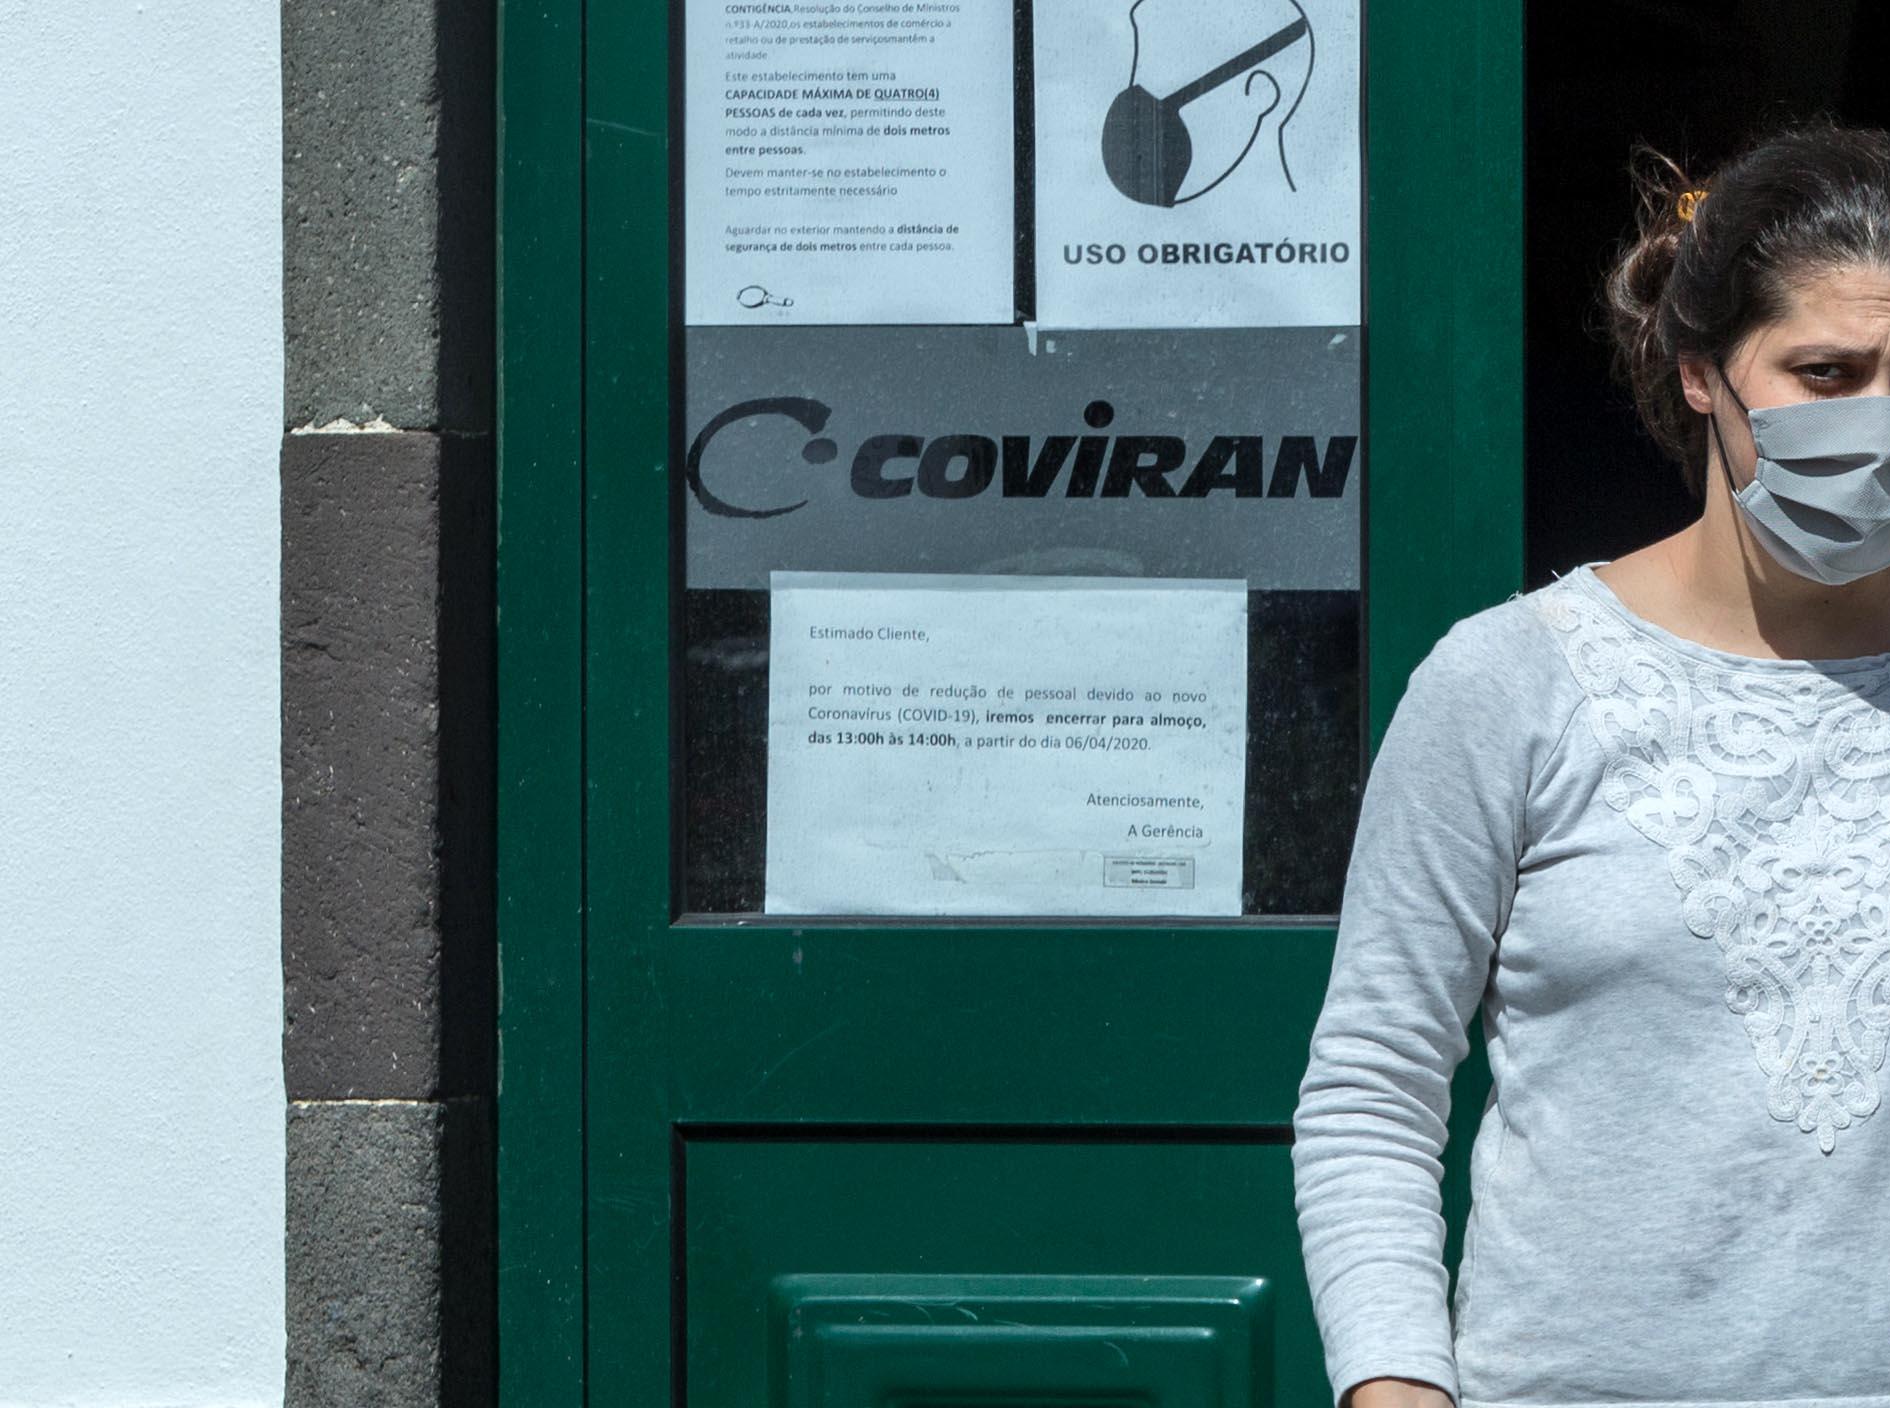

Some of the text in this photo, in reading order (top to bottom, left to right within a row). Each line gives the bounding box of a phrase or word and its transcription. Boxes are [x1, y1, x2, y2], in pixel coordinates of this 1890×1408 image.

[725, 71, 896, 82] Este estabelecimento tem uma
[725, 90, 799, 100] CAPACIDADE
[802, 87, 853, 99] MÁXIMA
[856, 90, 871, 99] DE
[725, 108, 776, 118] PESSOAS
[778, 107, 793, 118] de
[796, 107, 822, 118] cada
[850, 106, 912, 120] permitindo
[915, 106, 946, 117] deste
[725, 126, 757, 137] modo
[770, 125, 819, 137] distância
[822, 125, 864, 136] mínima
[866, 125, 881, 136] de
[883, 125, 907, 136] dois
[910, 126, 950, 136] metros
[725, 145, 756, 155] entre
[725, 168, 764, 178] Devem
[767, 168, 824, 178] manter-se
[826, 169, 841, 177] no
[844, 167, 936, 178] estabelecimento
[725, 185, 898, 198] tempo estritamente necessário
[725, 225, 771, 237] Aguardar
[774, 226, 788, 234] no
[790, 225, 830, 235] exterior
[833, 225, 886, 234] mantendo
[897, 224, 944, 234] distância
[946, 224, 959, 234] de
[725, 243, 777, 254] segurança
[780, 242, 793, 252] de
[796, 242, 818, 252] dois
[820, 242, 857, 251] metros
[859, 242, 886, 251] entre
[889, 242, 914, 251] cada
[1063, 237, 1350, 265] USO OBRIGATÓRIO
[809, 626, 930, 644] Estimado Cliente,
[808, 684, 1207, 703] por motivo de redução de pessoal devido ao novo
[808, 706, 1207, 730] Coronavírus (COVID-19), iremos encerrar para almoço,
[808, 731, 1151, 752] das 13:00h às 14:00h, a partir do dia 06/04/2020.
[1086, 792, 1205, 810] Atenciosamente,
[1127, 823, 1204, 840] A Gerência
